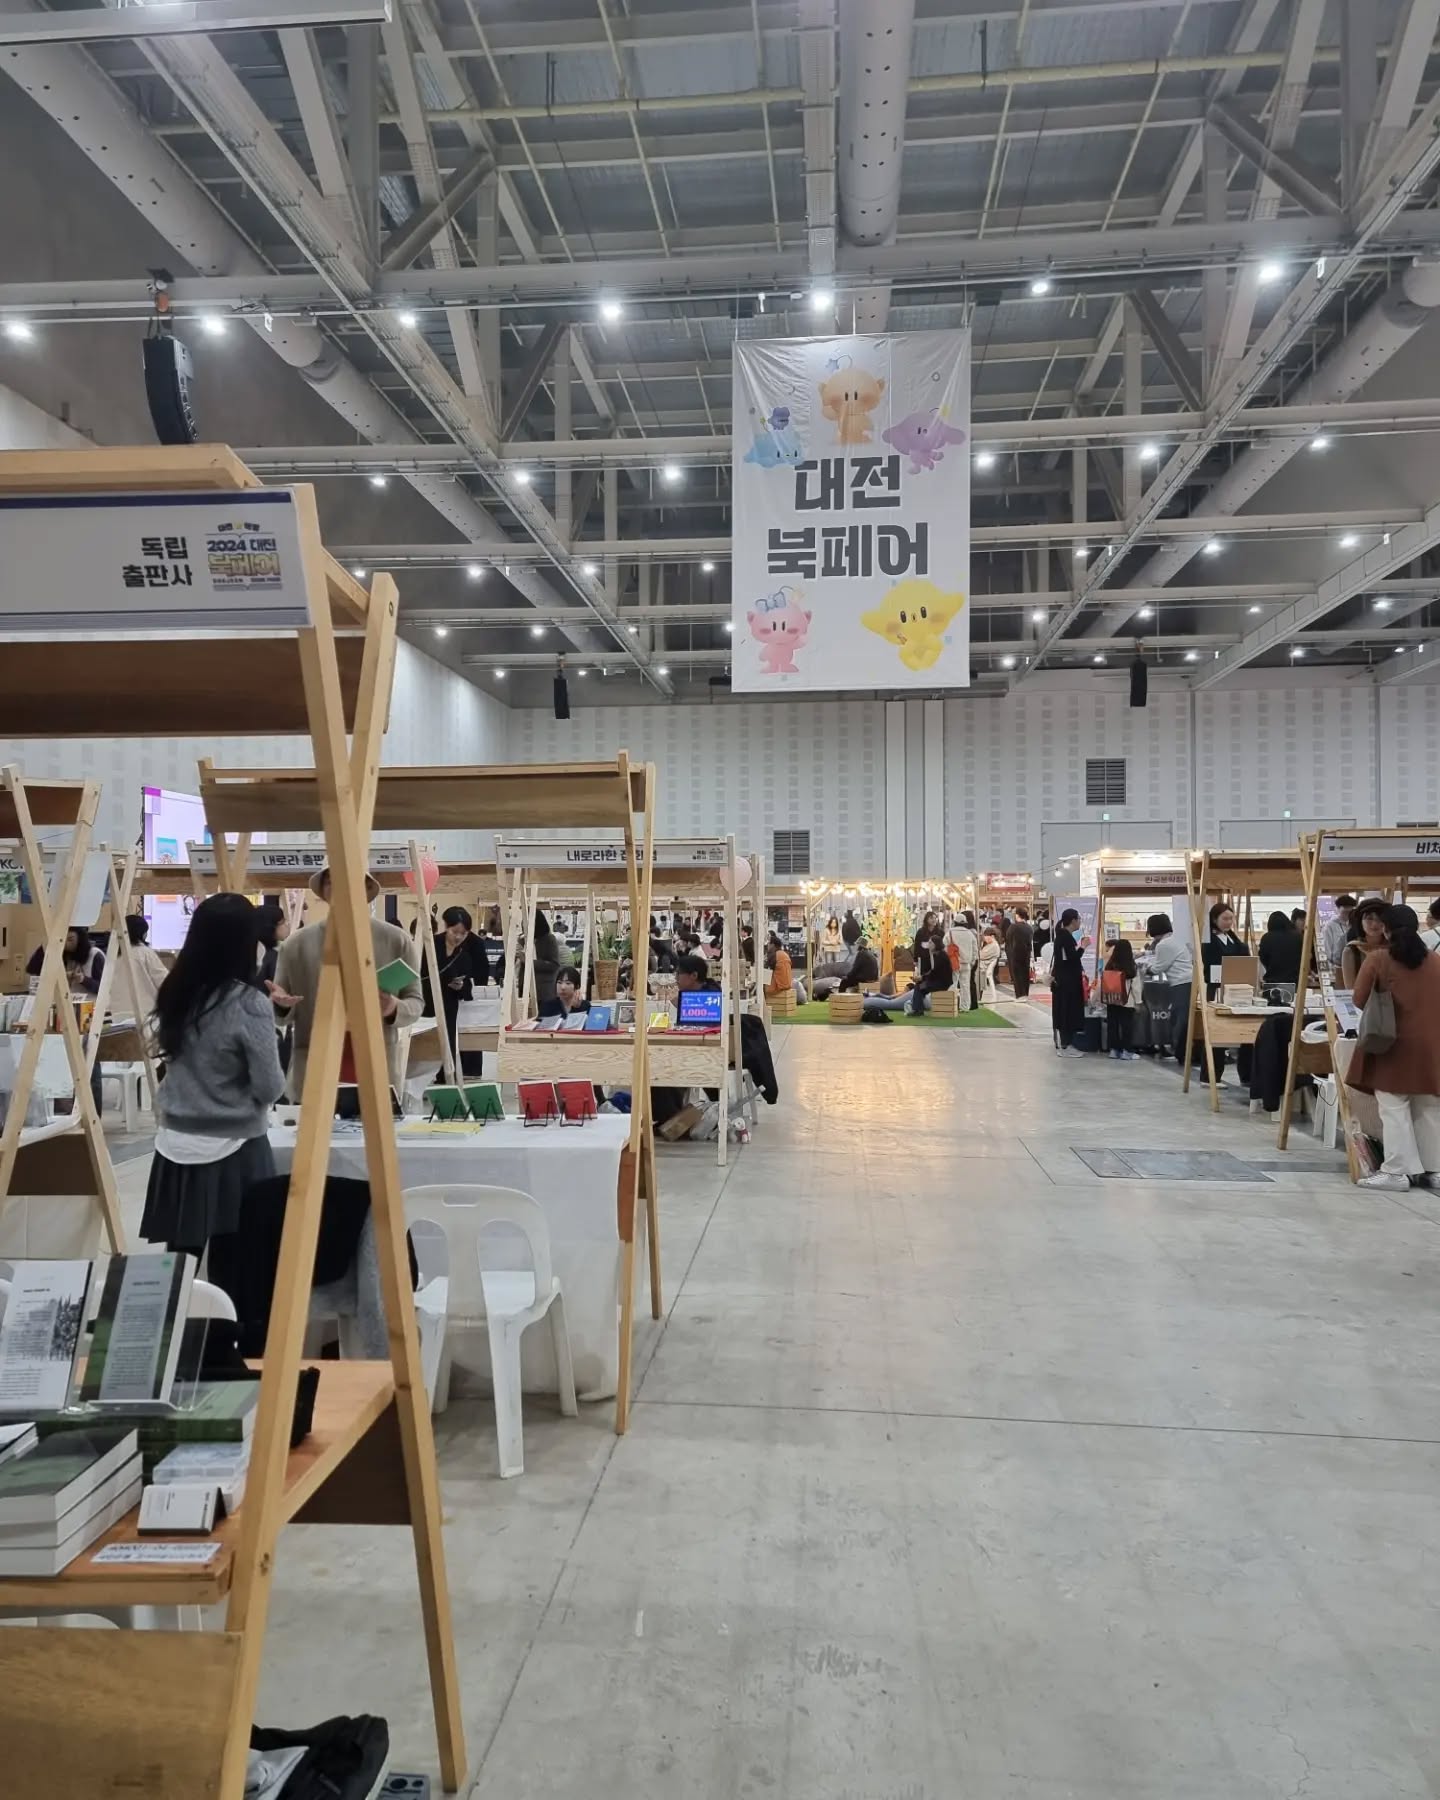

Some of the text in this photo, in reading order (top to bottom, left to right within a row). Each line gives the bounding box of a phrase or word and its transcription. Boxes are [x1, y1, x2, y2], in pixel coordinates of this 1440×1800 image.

[794, 454, 901, 511] 대전
[141, 536, 188, 560] 독립
[206, 540, 247, 552] 2024
[766, 521, 929, 580] 북페어
[122, 564, 193, 588] 출판사
[262, 854, 326, 866] 내로라 출판
[567, 850, 618, 862] 내로라한
